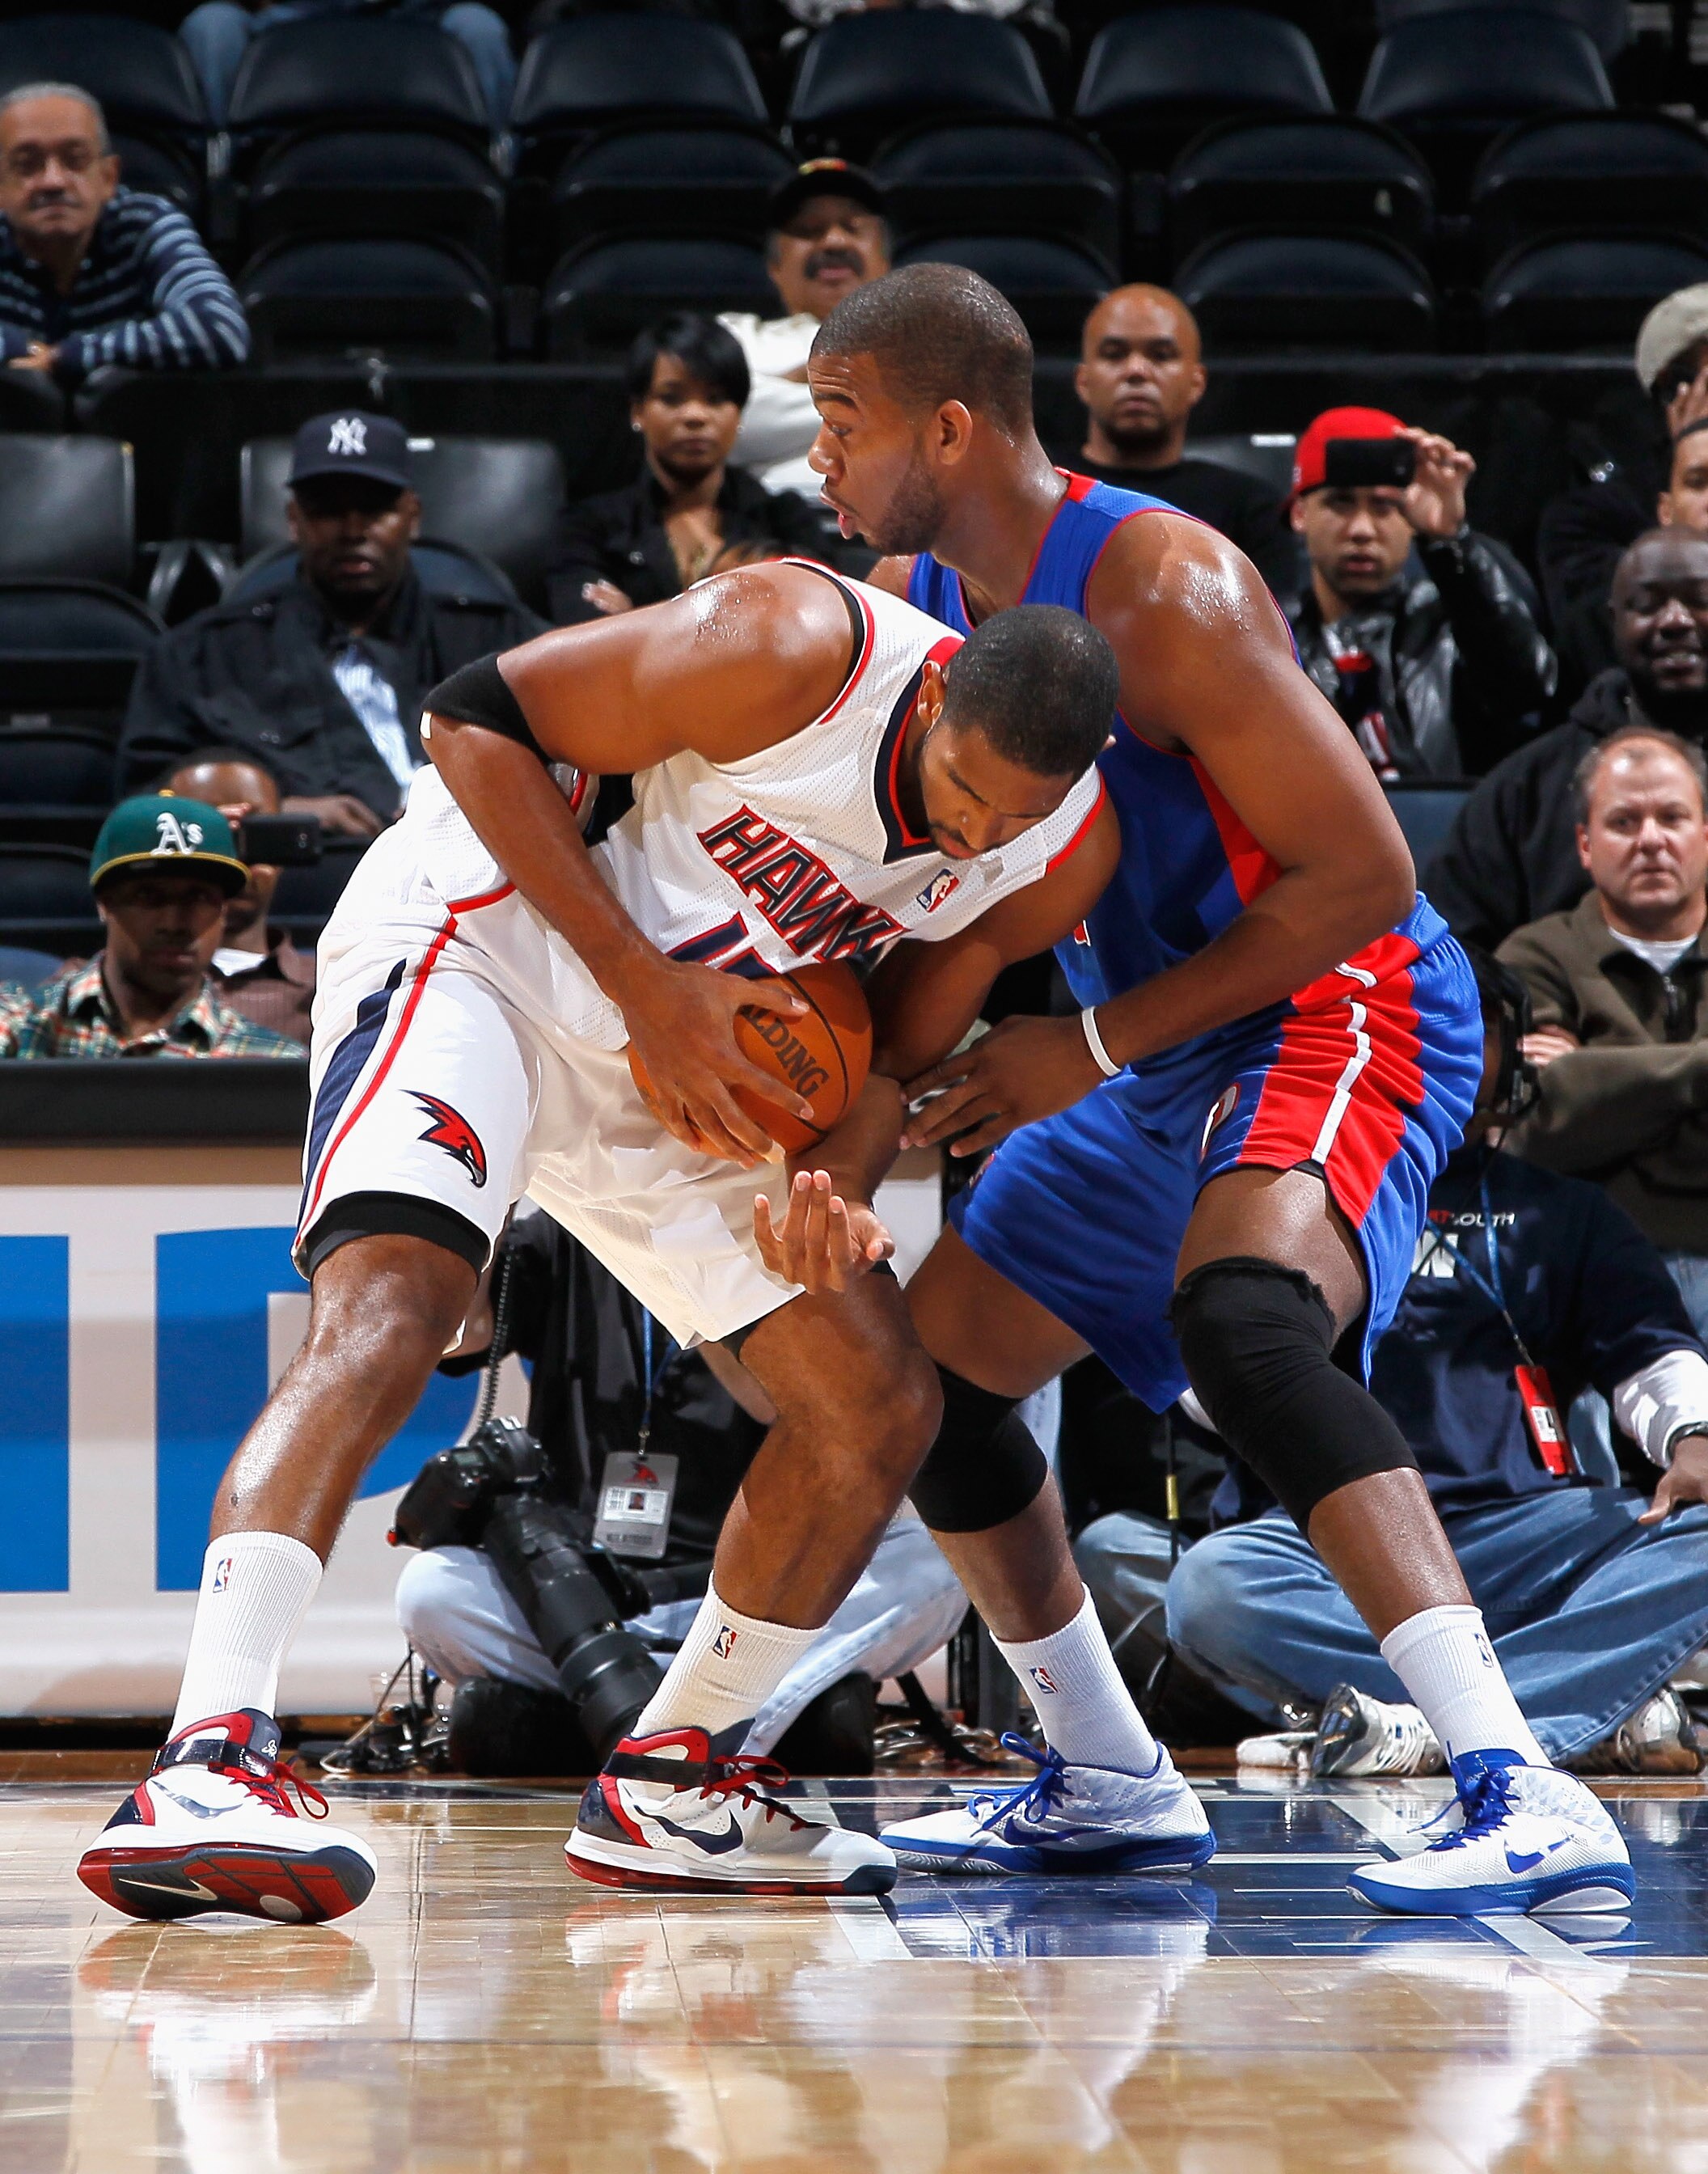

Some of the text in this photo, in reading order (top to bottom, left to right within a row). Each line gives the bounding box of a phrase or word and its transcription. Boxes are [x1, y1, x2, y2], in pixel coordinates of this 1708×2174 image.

[328, 417, 367, 455] NY
[150, 811, 204, 856] A's
[696, 803, 907, 964] HAWK
